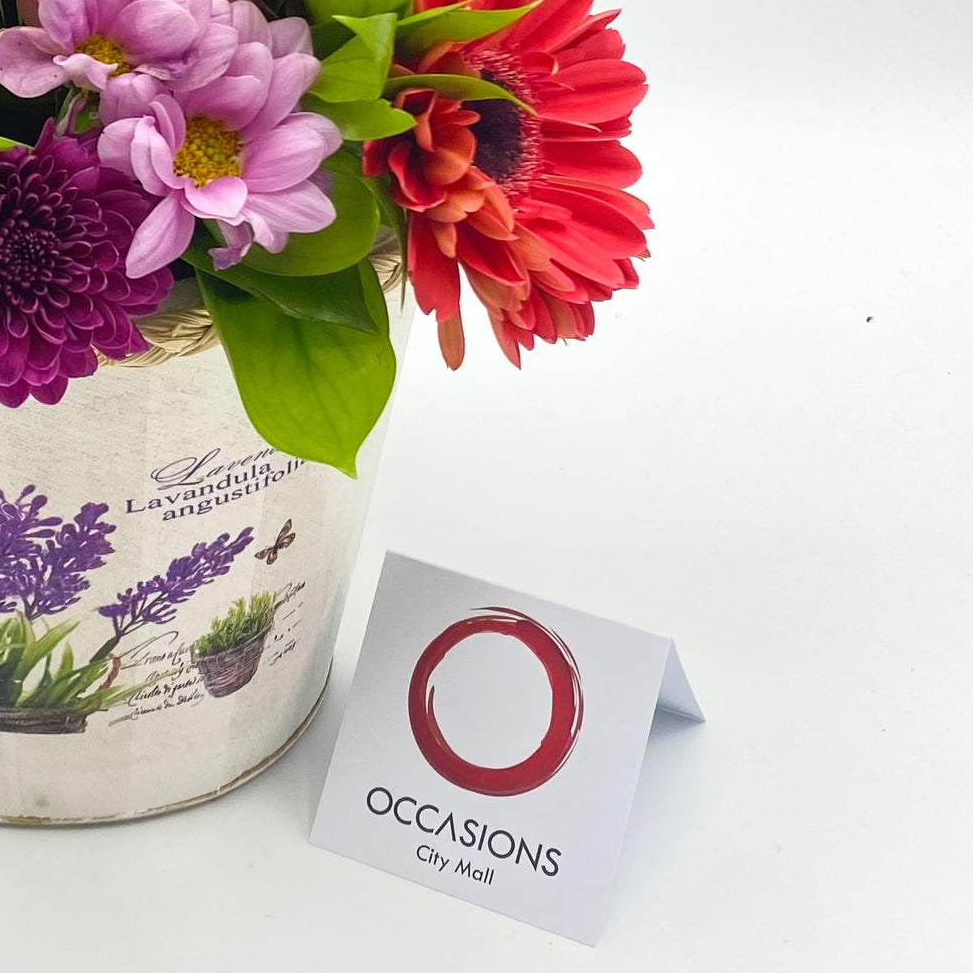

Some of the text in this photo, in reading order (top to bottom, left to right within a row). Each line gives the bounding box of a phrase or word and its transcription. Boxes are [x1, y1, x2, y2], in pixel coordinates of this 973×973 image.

[125, 463, 271, 514] Lavandula
[366, 786, 562, 877] OCCASIONS
[416, 844, 494, 885] City Mall
